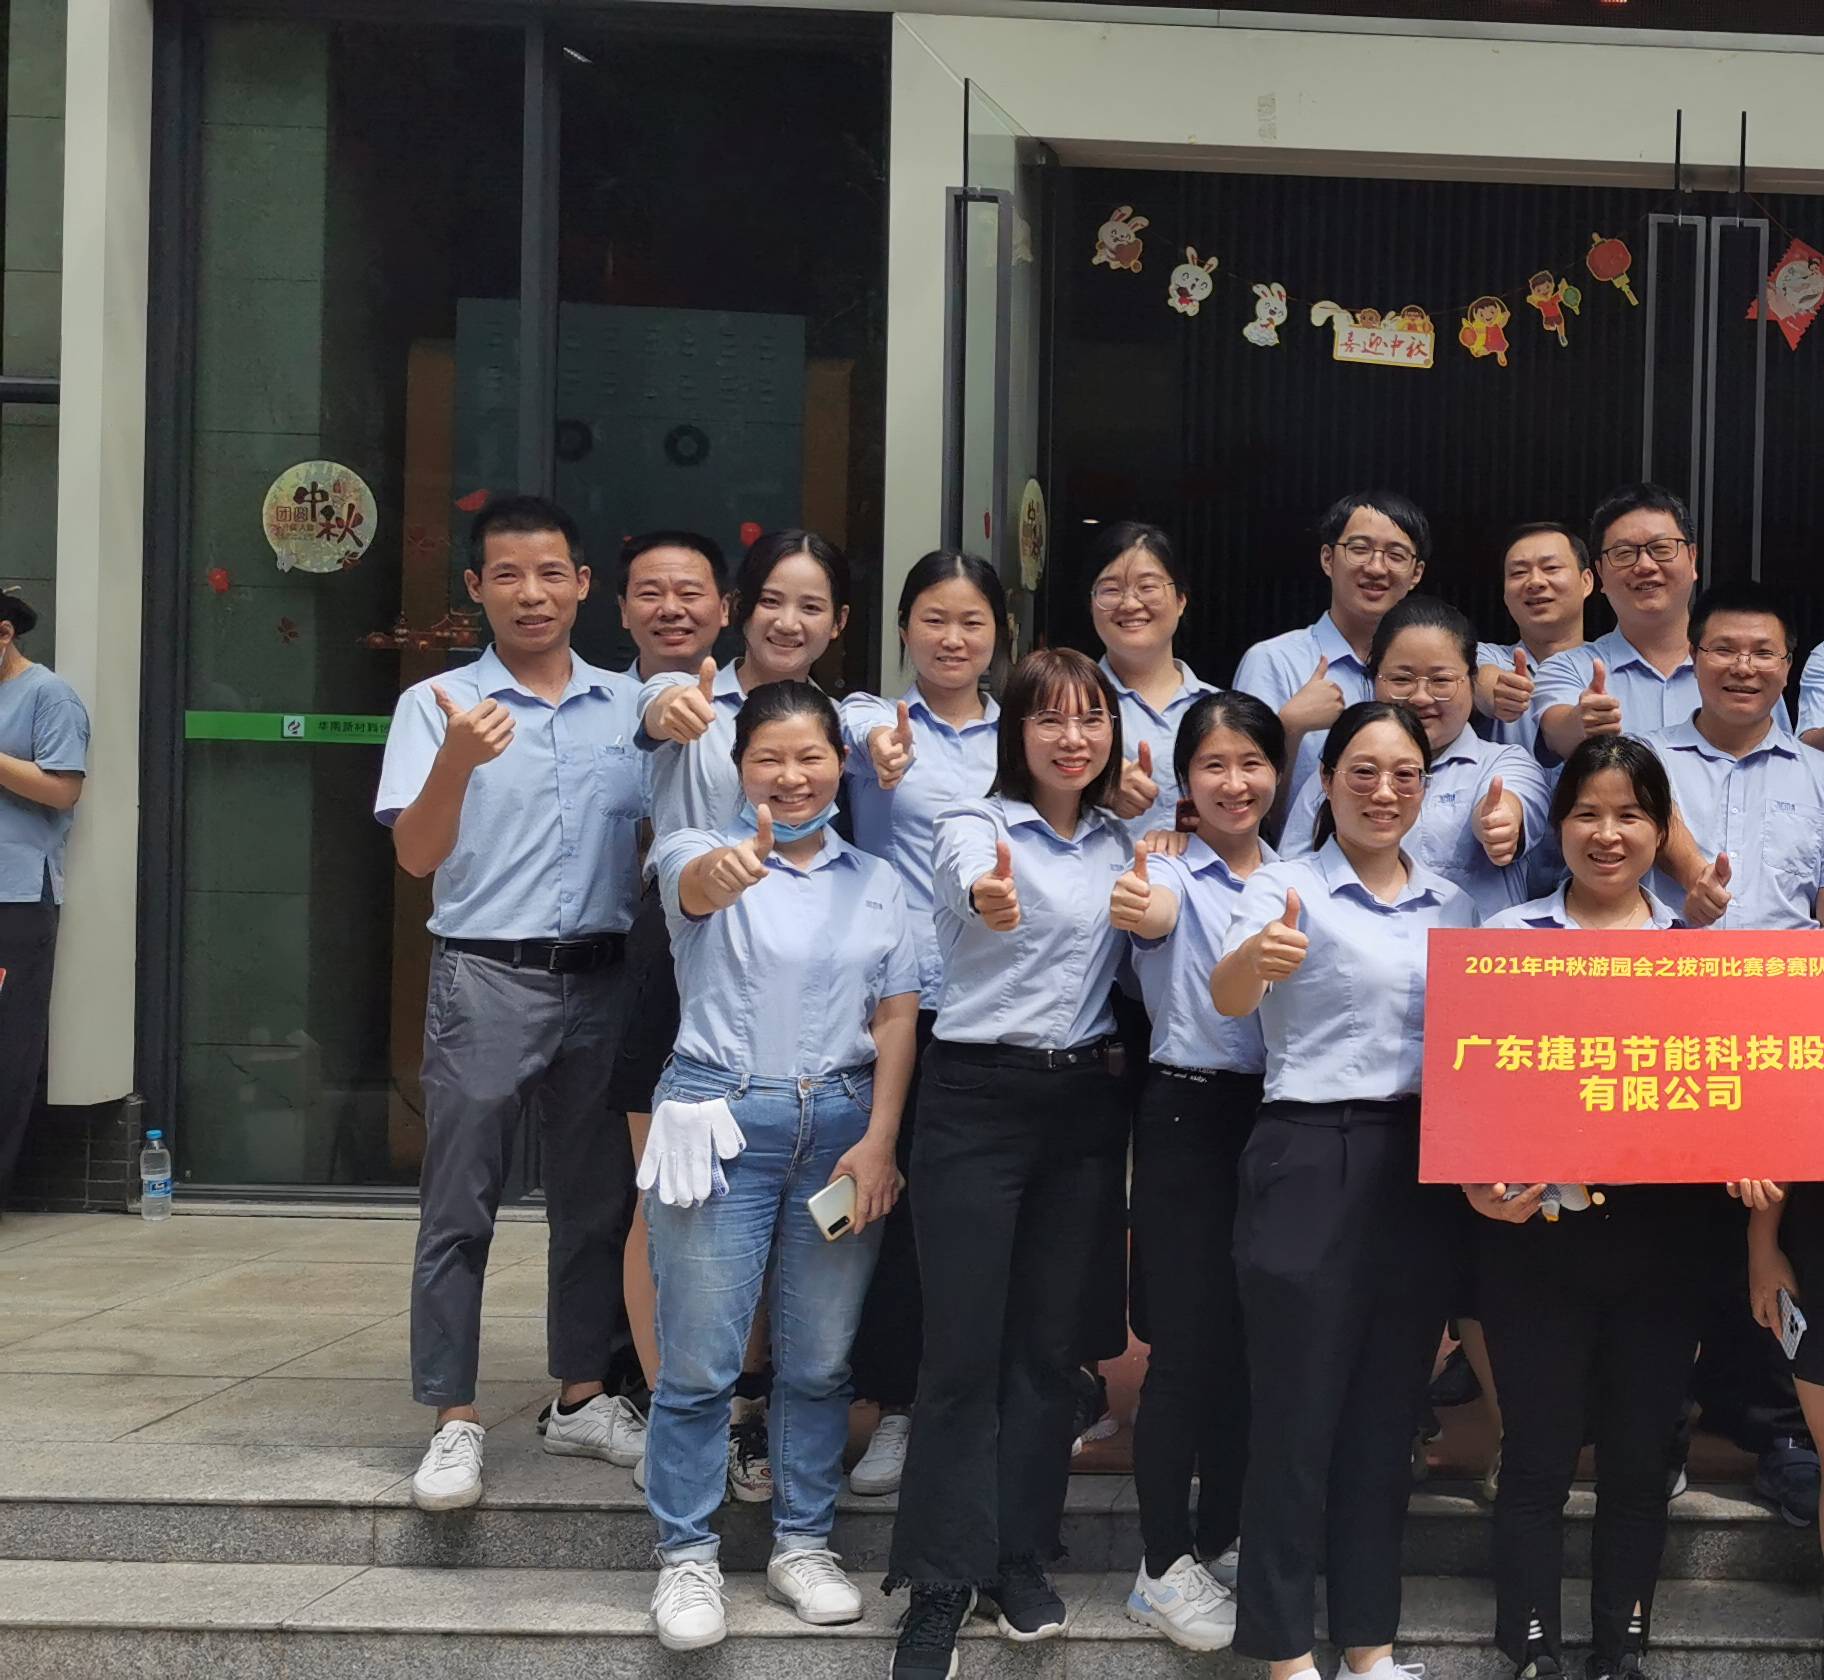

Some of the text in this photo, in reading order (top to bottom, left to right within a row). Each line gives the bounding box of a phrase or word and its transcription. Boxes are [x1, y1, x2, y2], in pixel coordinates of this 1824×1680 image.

[1340, 331, 1428, 358] 喜迎中秋
[293, 481, 364, 547] 中秋
[1579, 1074, 1743, 1112] 有限公司
